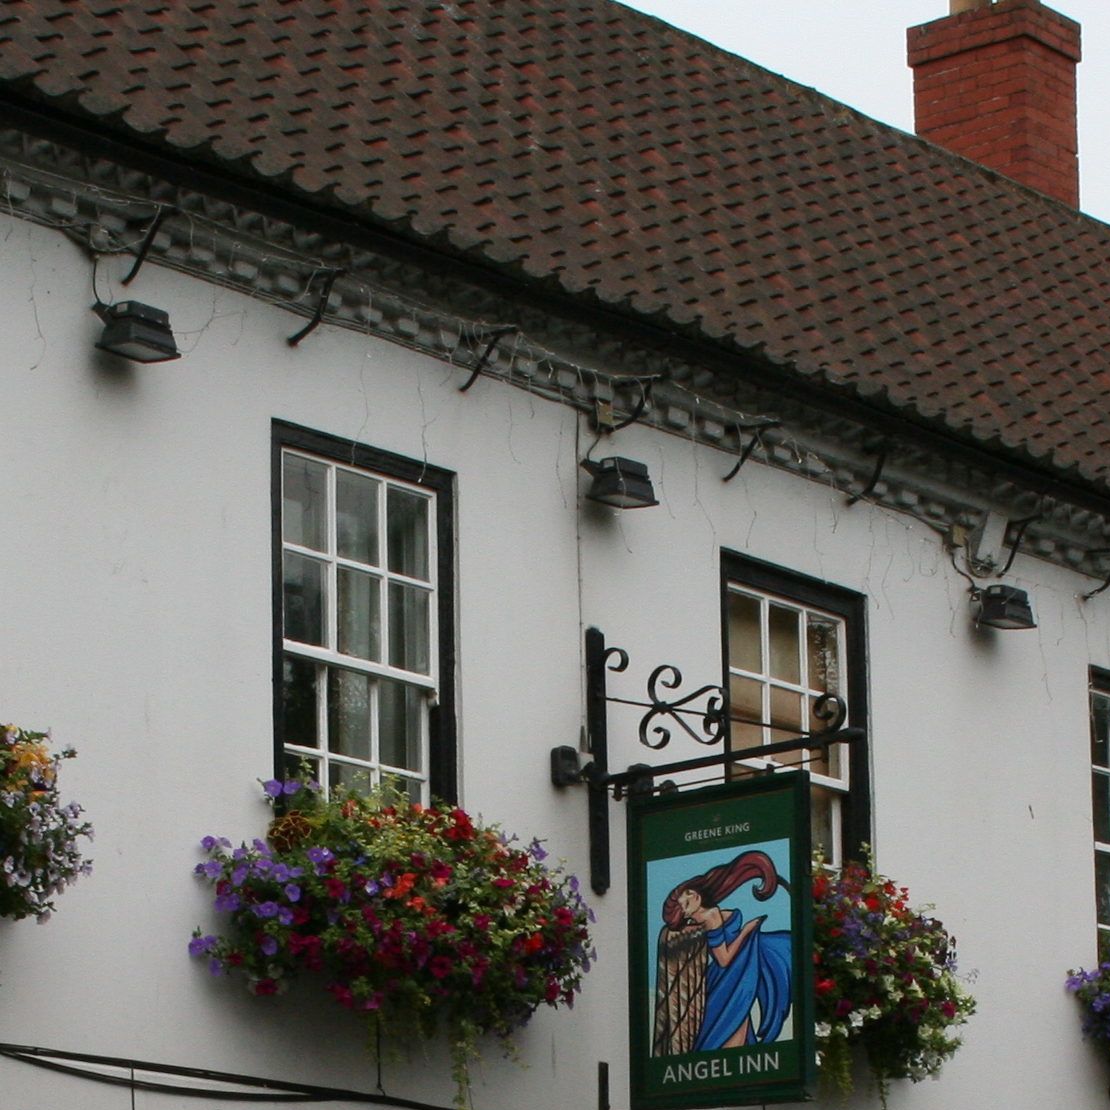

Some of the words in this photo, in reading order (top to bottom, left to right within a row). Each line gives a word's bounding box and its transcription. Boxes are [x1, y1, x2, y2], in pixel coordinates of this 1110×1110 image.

[684, 826, 722, 842] GREENE
[724, 822, 750, 835] KING
[662, 1057, 732, 1085] ANGEL
[739, 1051, 780, 1075] INN
